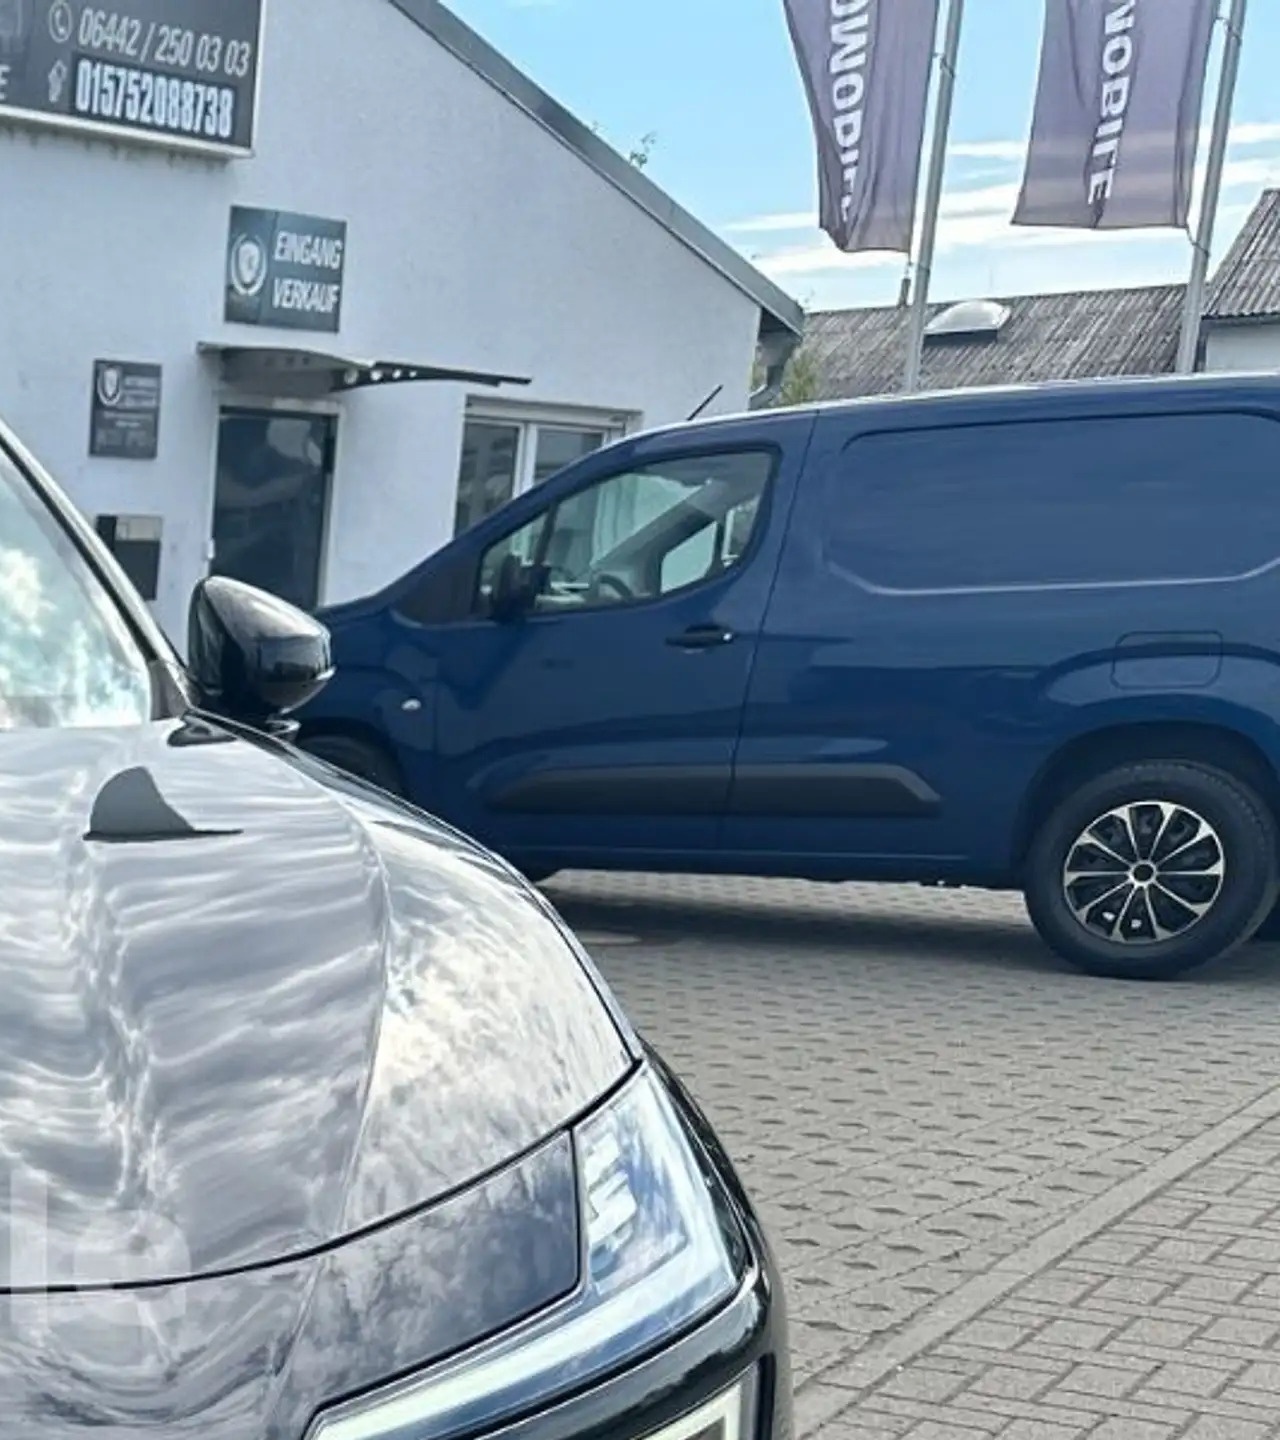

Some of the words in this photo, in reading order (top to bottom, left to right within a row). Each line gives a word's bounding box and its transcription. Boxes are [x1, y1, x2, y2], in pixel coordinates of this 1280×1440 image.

[78, 8, 141, 56] 06442
[154, 25, 194, 67] 250
[195, 33, 222, 72] 03
[223, 40, 251, 77] 03
[75, 59, 235, 138] 015752088738
[274, 231, 342, 270] EINGANG
[272, 277, 339, 313] VERKAUF
